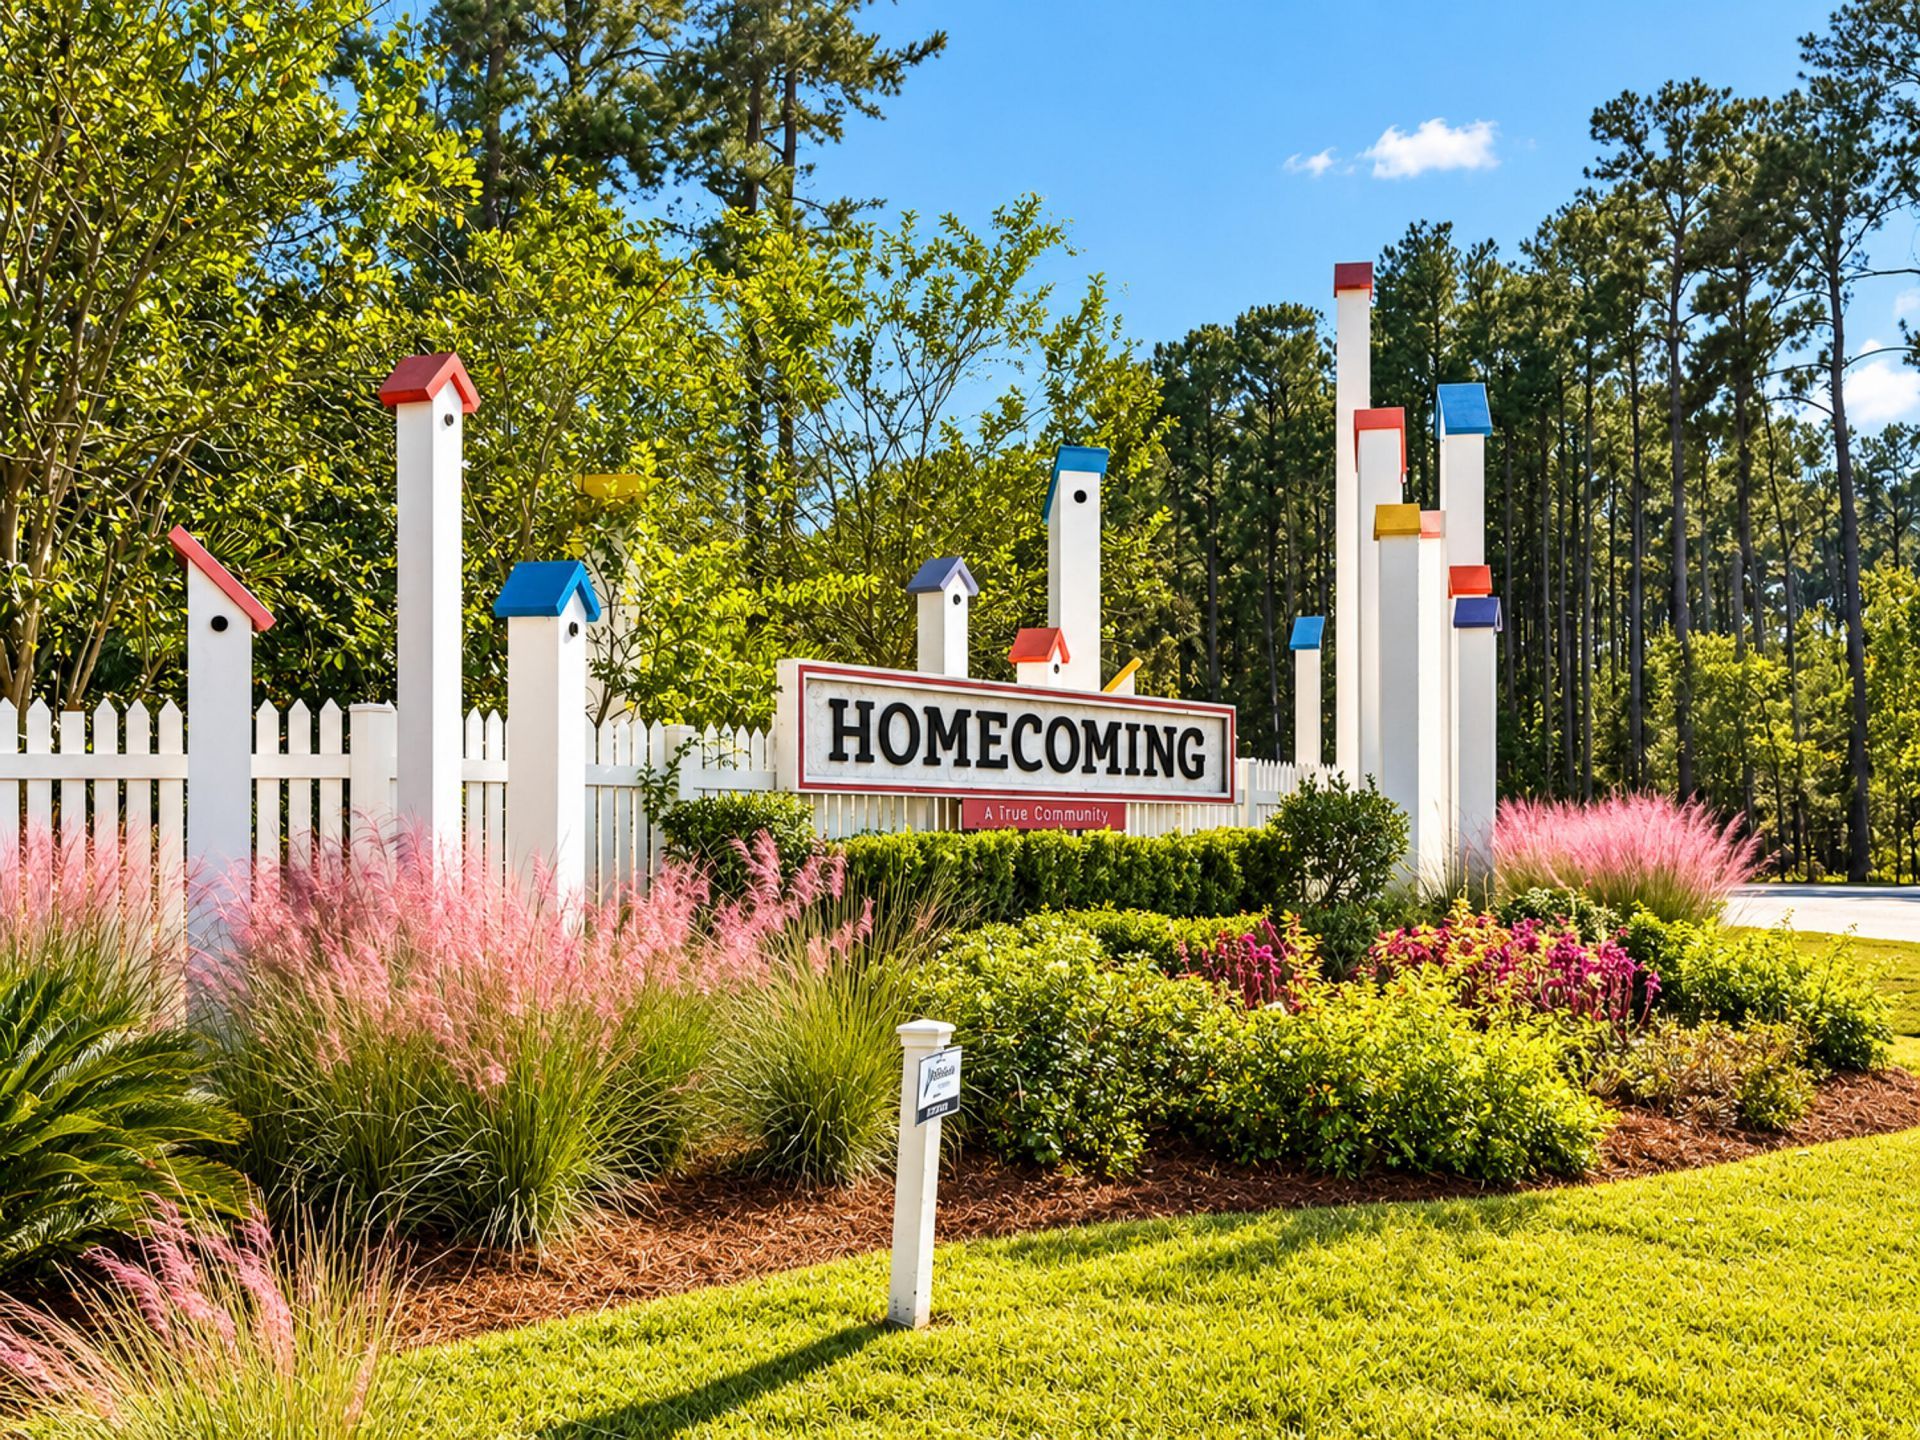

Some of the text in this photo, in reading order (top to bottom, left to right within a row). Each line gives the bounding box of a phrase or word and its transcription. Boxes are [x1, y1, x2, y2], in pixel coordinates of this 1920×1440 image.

[828, 698, 1206, 780] HOMECOMING
[984, 805, 1108, 824] A True Community
